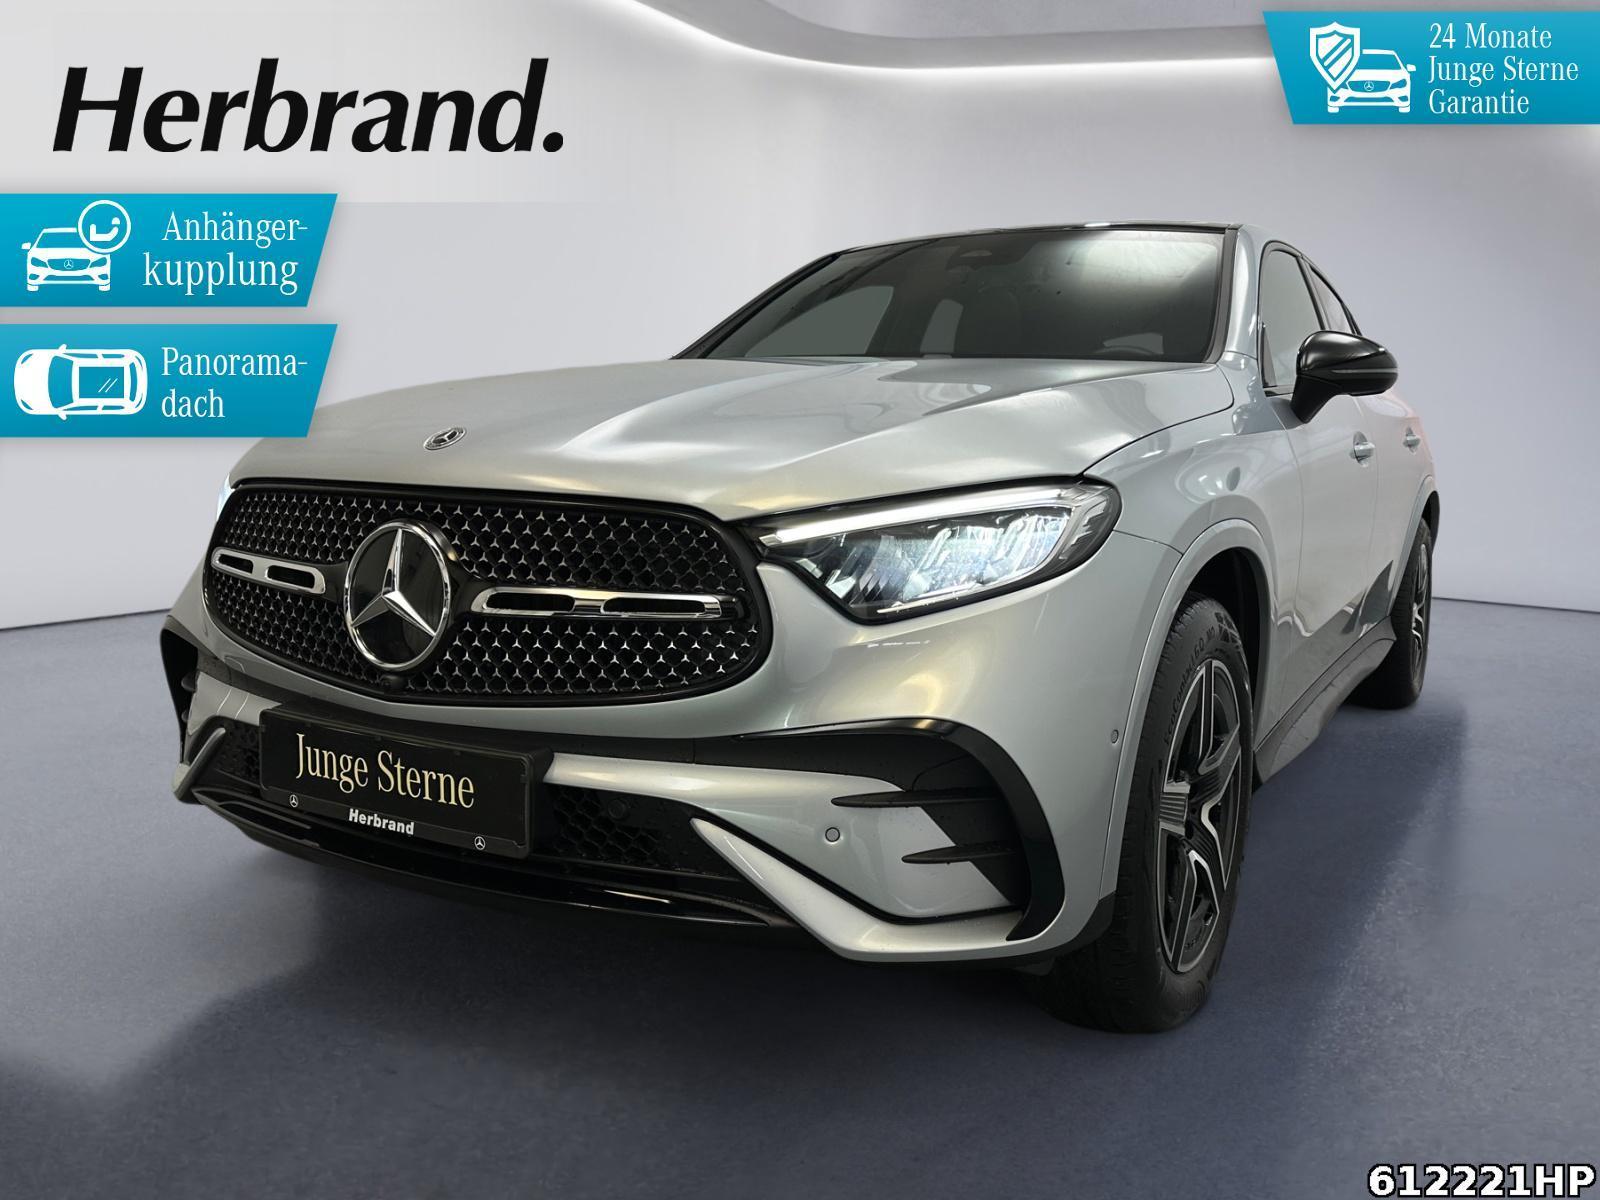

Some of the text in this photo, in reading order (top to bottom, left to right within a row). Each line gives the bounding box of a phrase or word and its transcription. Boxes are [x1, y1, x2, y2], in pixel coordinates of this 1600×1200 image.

[295, 732, 475, 809] Junge Sterne
[348, 808, 415, 836] Herbrand
